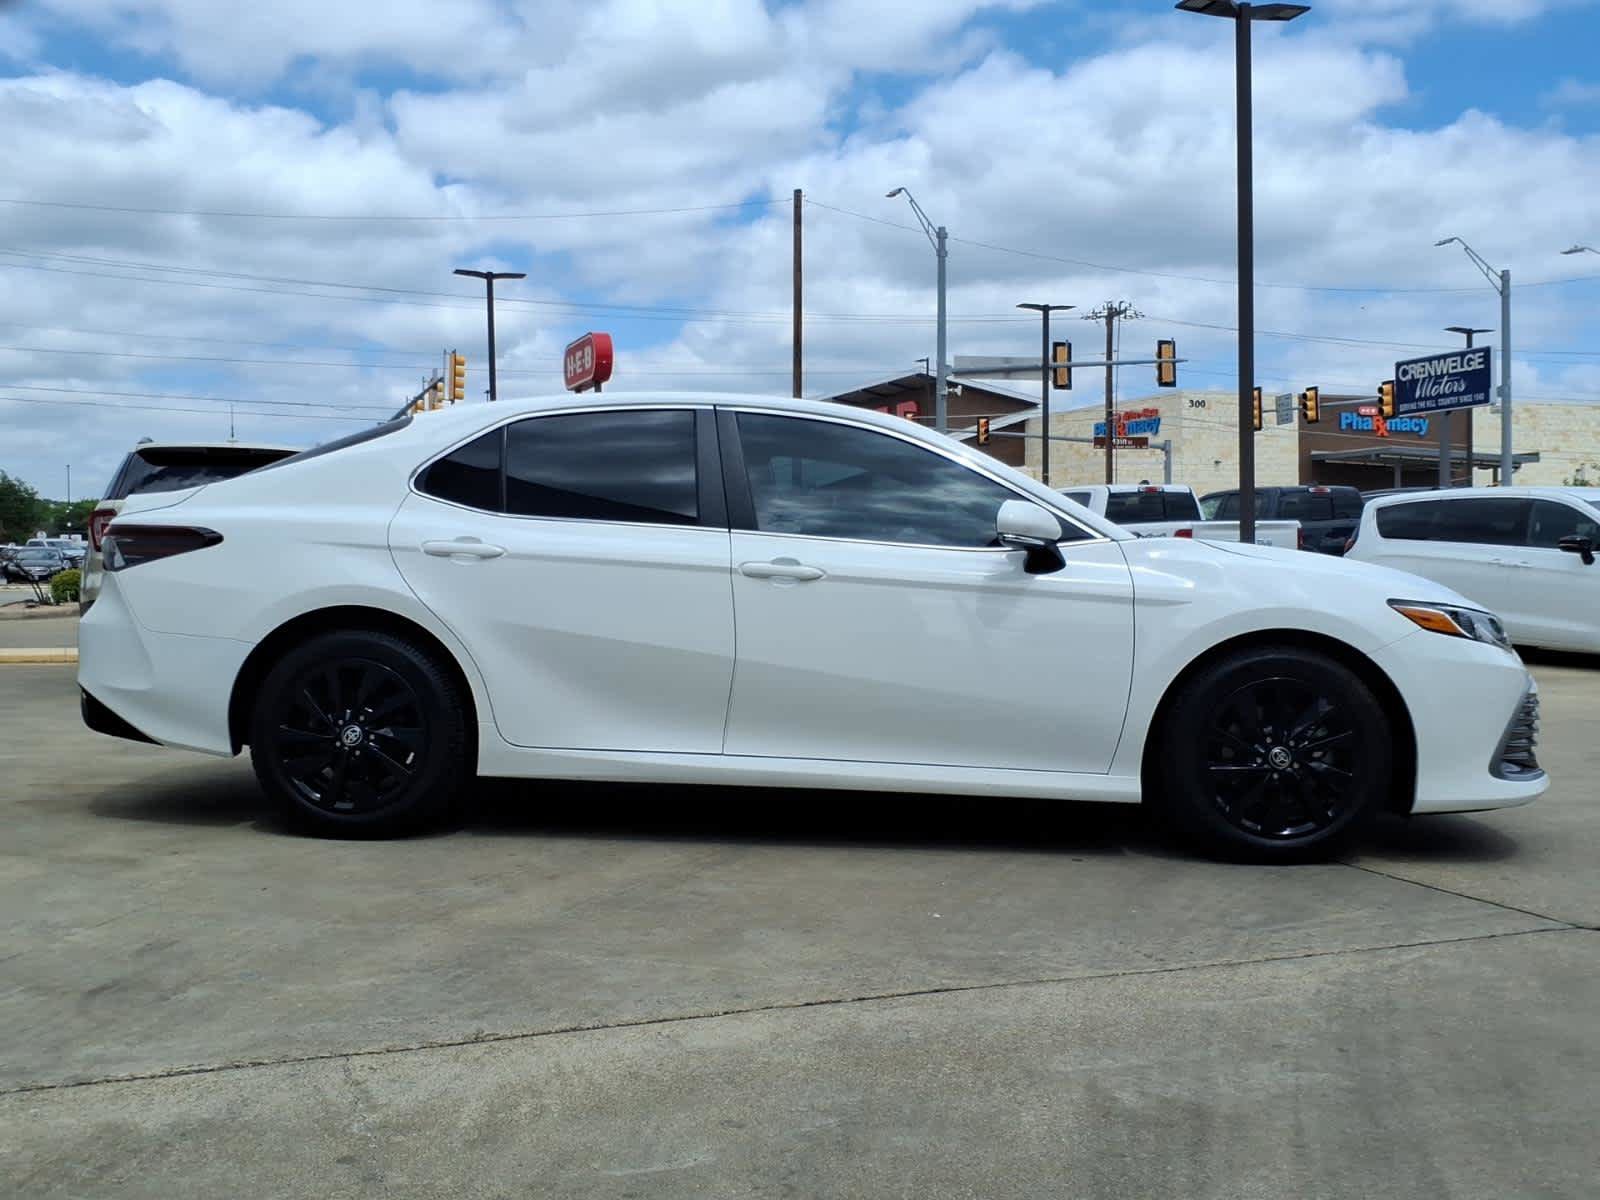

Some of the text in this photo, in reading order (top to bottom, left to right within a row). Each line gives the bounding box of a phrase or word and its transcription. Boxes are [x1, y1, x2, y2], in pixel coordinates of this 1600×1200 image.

[1398, 352, 1485, 382] CRENWELGE
[1415, 375, 1466, 399] Motors
[1189, 399, 1206, 409] 300
